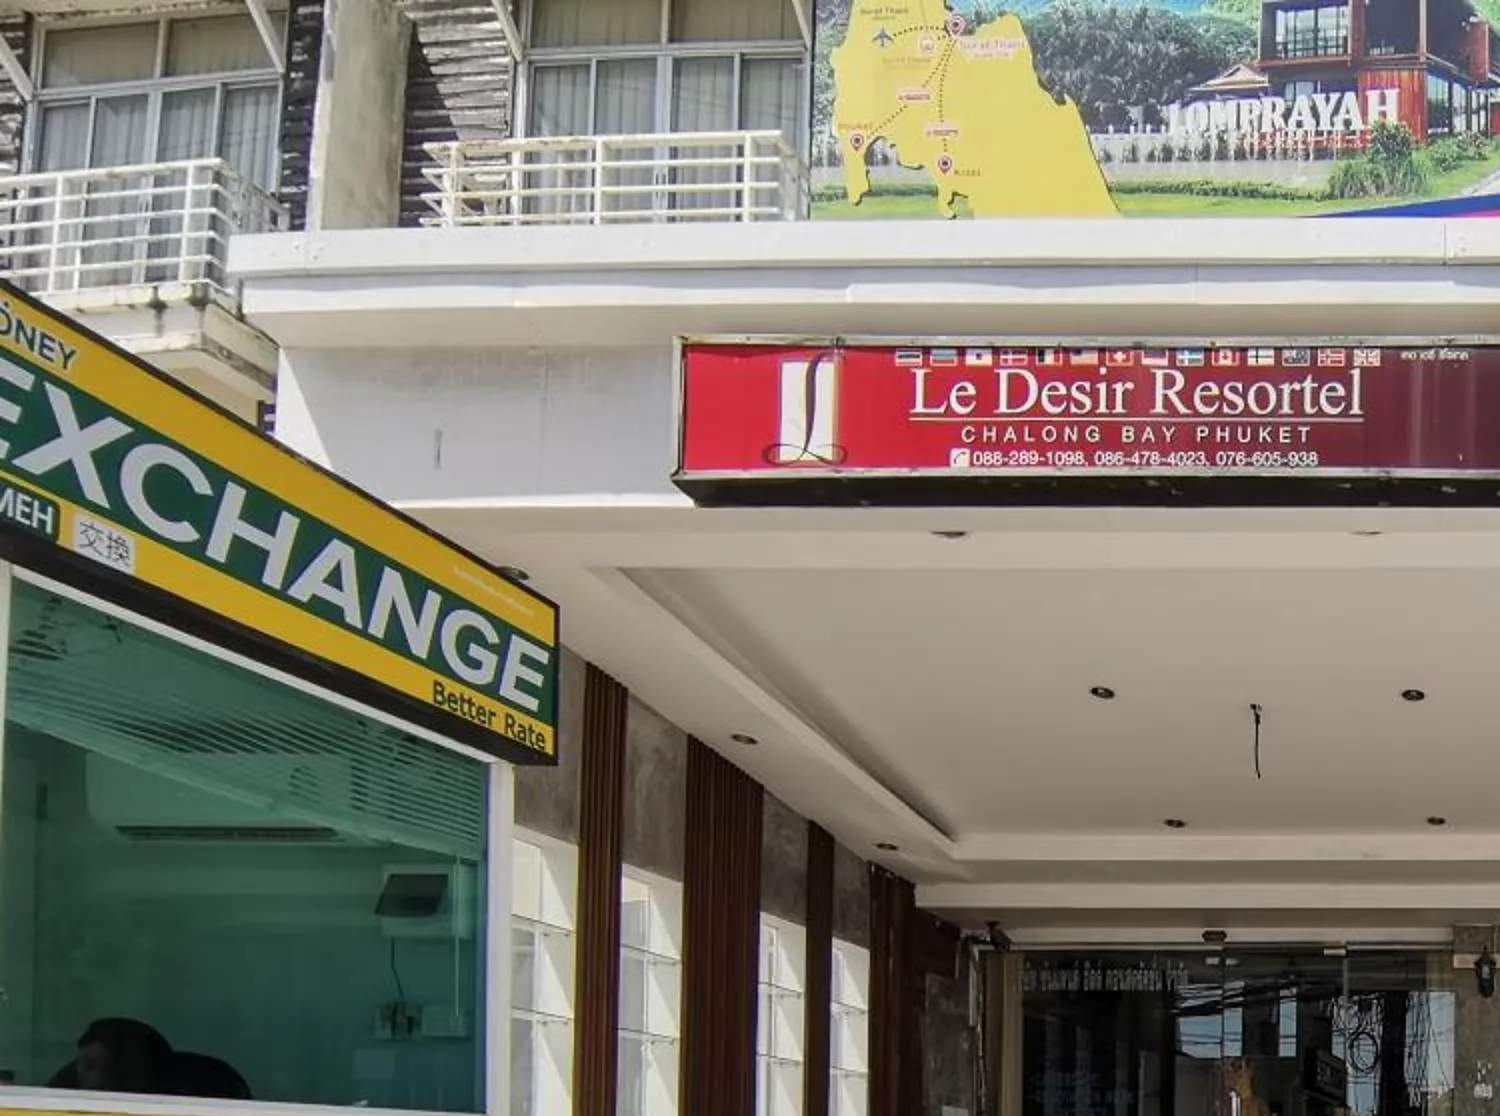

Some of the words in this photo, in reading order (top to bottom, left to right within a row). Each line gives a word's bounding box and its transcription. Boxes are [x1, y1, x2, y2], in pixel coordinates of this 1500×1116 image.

[909, 367, 977, 415] Le
[994, 367, 1133, 415] Desir
[1151, 367, 1364, 415] Resortel
[961, 425, 1101, 444] CHALONG
[1121, 424, 1177, 444] BAY
[1196, 425, 1311, 444] PHUKET
[432, 680, 497, 729] Better
[504, 713, 547, 750] Rate
